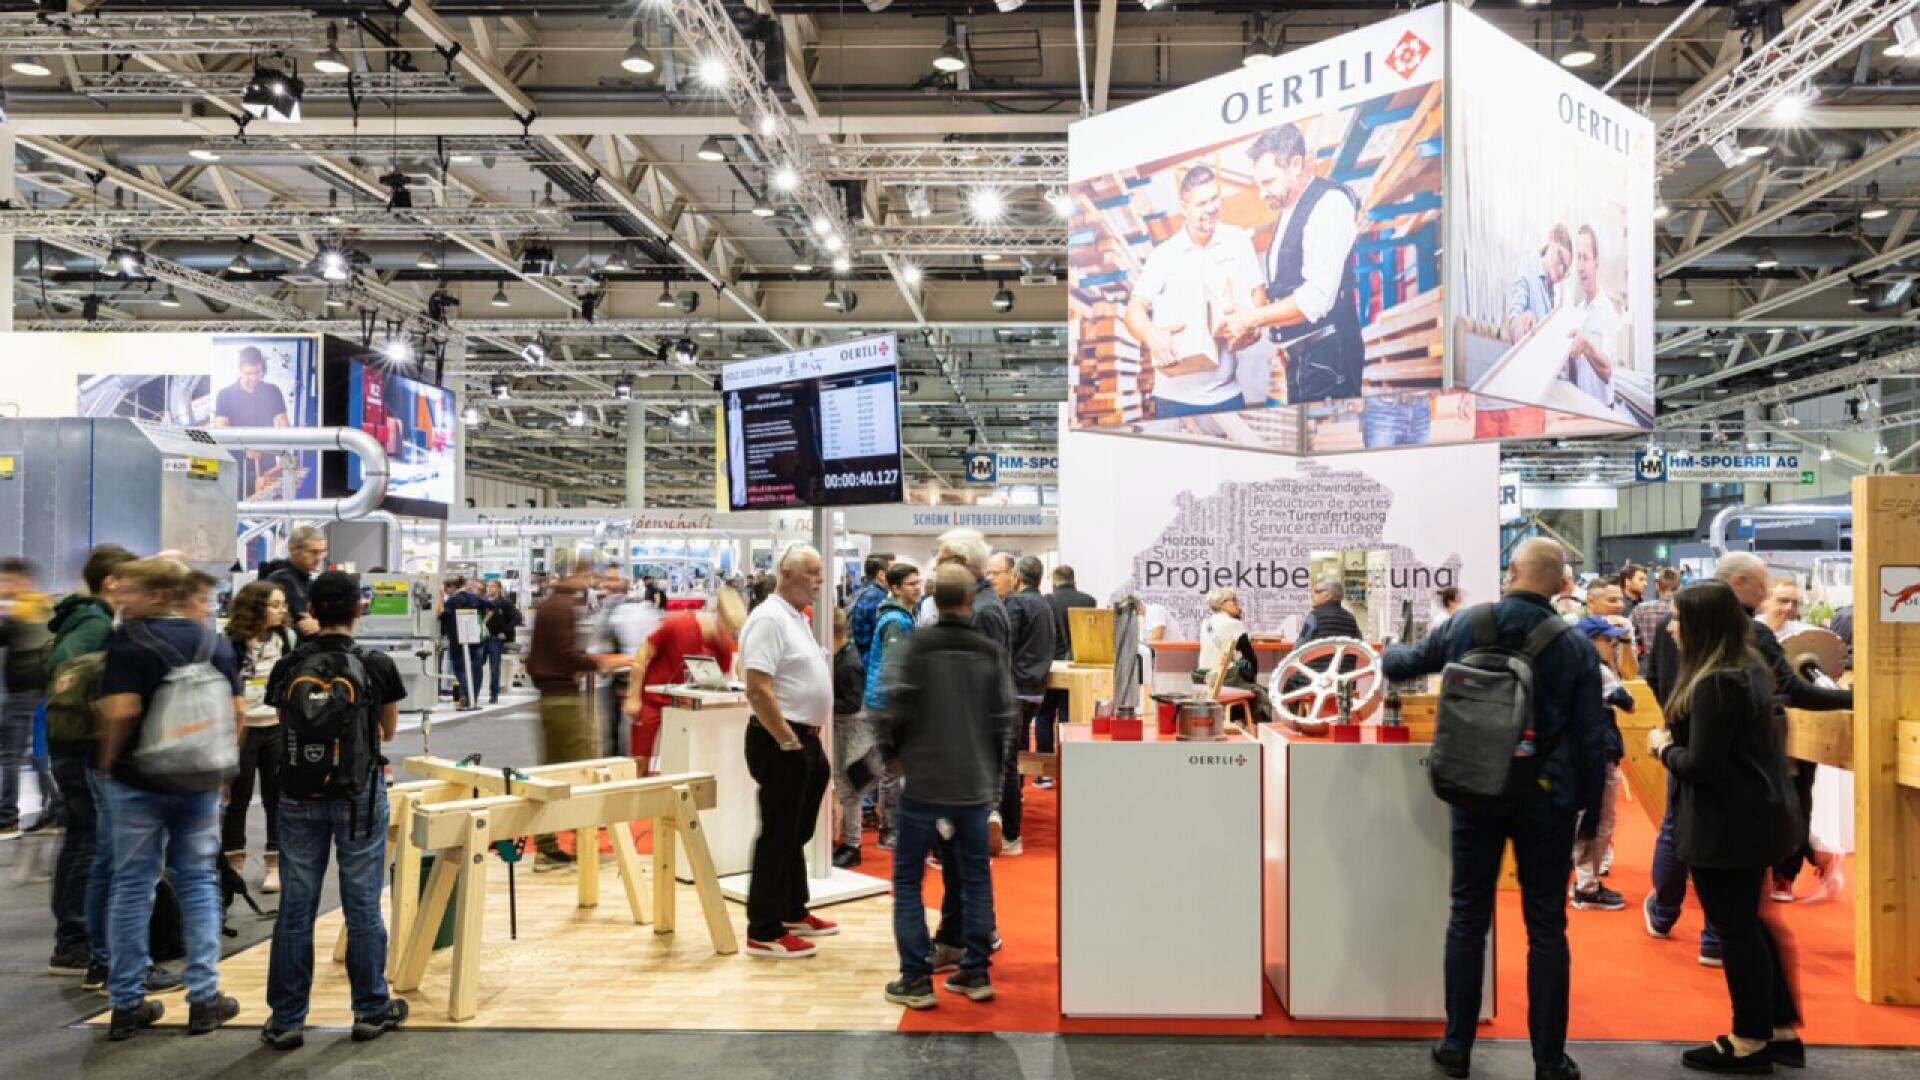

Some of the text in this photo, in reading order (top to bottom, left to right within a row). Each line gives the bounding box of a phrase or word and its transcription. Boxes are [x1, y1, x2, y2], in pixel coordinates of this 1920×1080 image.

[1220, 50, 1374, 126] OERTLI
[1557, 92, 1631, 156] OERTLI
[838, 347, 878, 361] OERTLI
[971, 462, 991, 476] HM
[1640, 460, 1662, 474] HM
[1670, 456, 1798, 468] HM-SPOERRI AG
[824, 470, 898, 489] 00:00:40.127
[1251, 483, 1381, 495] Schnittgeschwindigkeit
[1253, 497, 1391, 513] Production de portes
[913, 510, 1042, 526] SCHENK LUFTBEFEUCHTUNG
[1250, 519, 1303, 534] Service
[1162, 533, 1215, 547] Holzbau
[1153, 546, 1209, 561] Suisse
[1251, 542, 1285, 557] Suivi
[1290, 542, 1308, 557] de
[1146, 561, 1453, 596] Projektbeung
[1189, 755, 1233, 765] OERTLI
